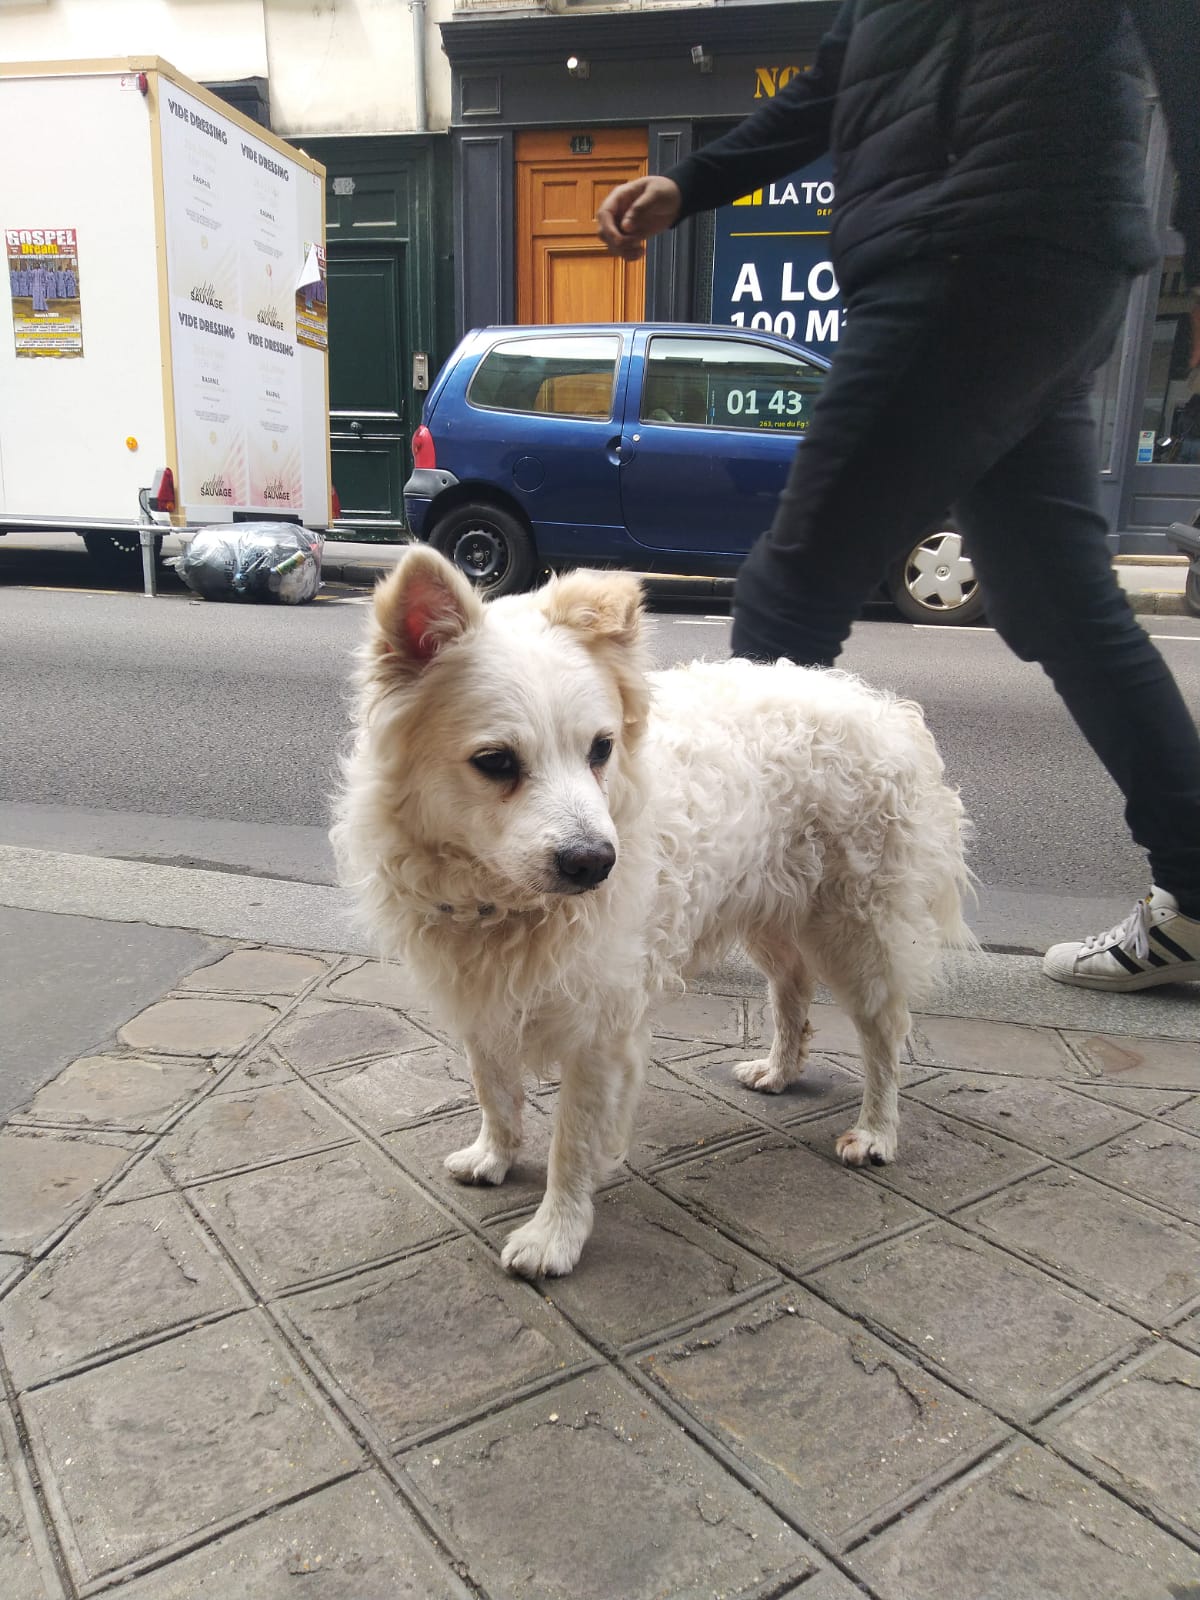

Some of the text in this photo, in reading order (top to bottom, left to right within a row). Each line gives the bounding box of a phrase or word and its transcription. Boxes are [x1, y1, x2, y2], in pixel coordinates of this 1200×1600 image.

[753, 66, 812, 98] NO
[168, 98, 228, 145] VIDE DRESSING
[241, 143, 258, 164] VIDE
[258, 153, 289, 182] DRESSING
[768, 183, 799, 206] LA
[6, 230, 76, 246] GOSPEL
[21, 243, 59, 255] Dream
[731, 263, 763, 302] A
[190, 290, 224, 310] SAUVAGE
[178, 312, 235, 340] VIDE DRESSING
[257, 313, 284, 331] SAUVAGE
[247, 332, 294, 357] VIDE DRESSING
[727, 389, 760, 415] 01
[768, 389, 803, 415] 43
[200, 487, 232, 498] SAUVAGE
[263, 490, 290, 501] SAUVAGE
